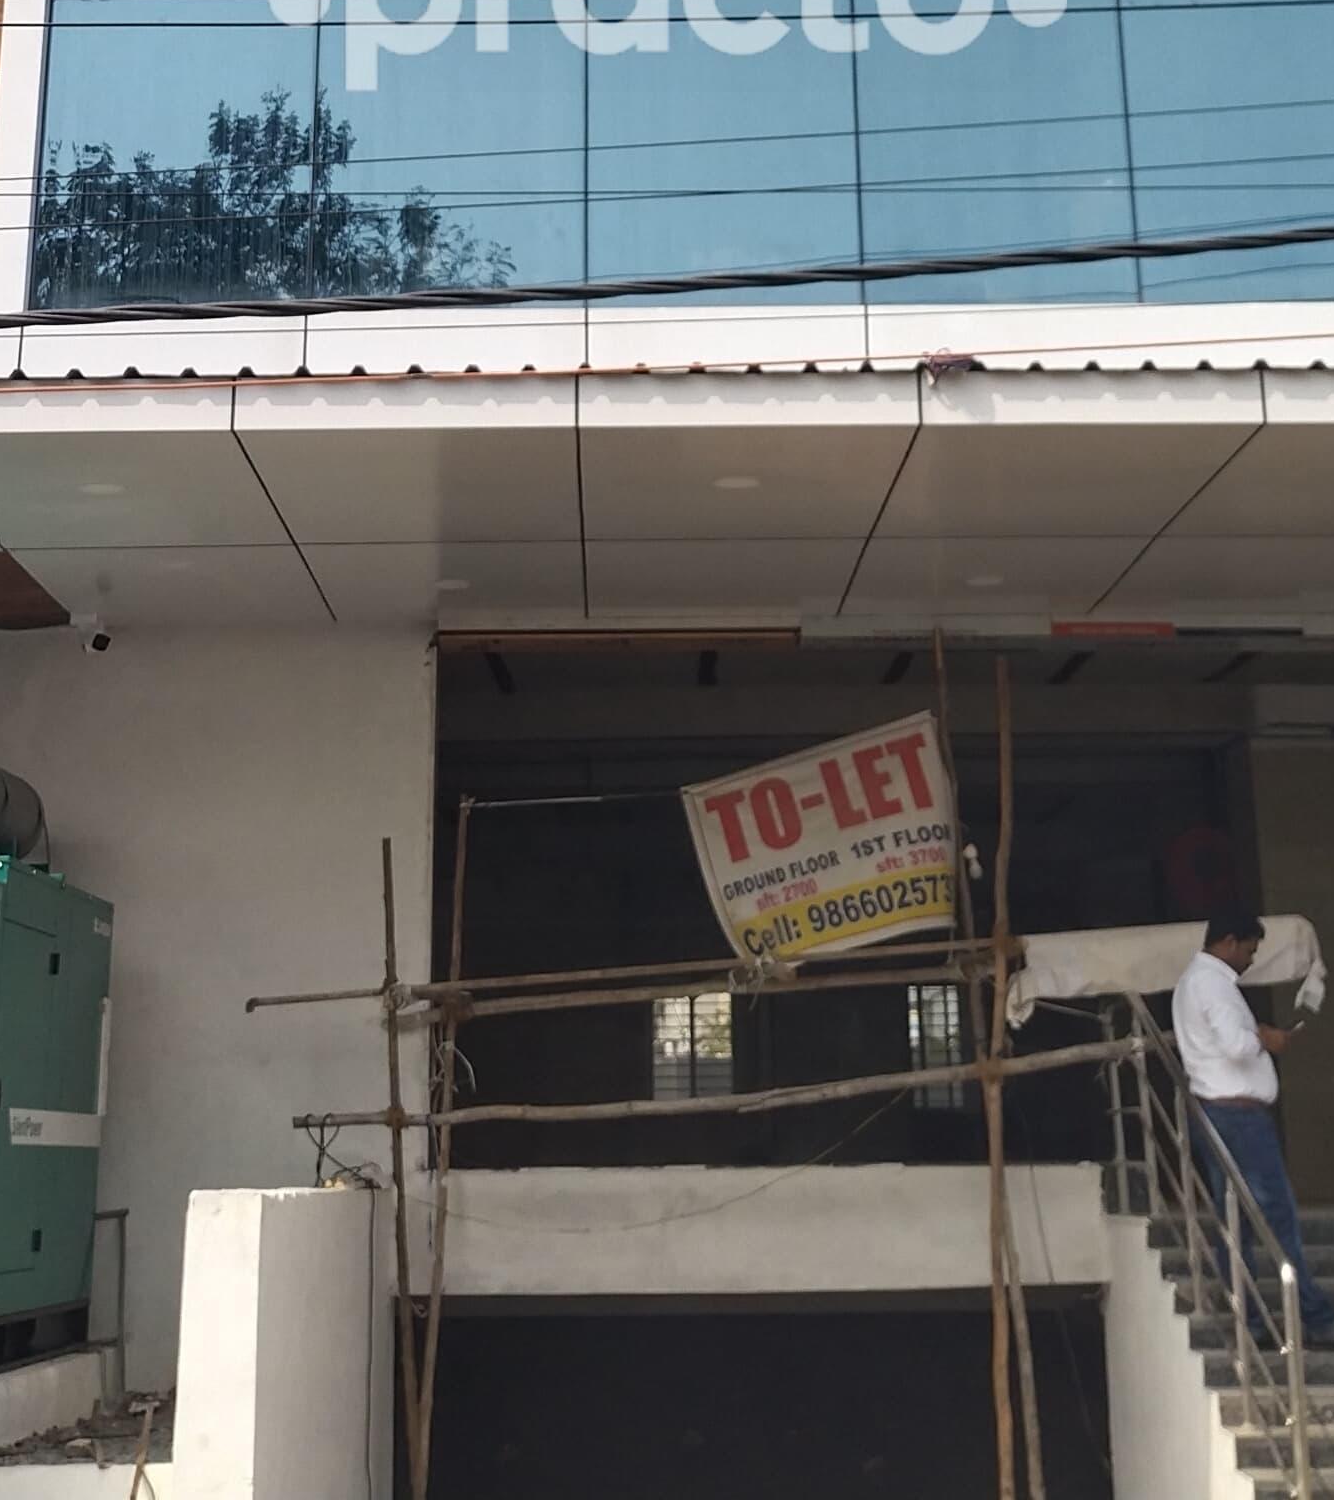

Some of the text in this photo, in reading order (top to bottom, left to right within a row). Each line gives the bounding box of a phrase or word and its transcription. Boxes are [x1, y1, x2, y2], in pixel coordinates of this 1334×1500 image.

[704, 732, 934, 863] TO-LET
[723, 866, 787, 901] GROUND
[789, 851, 841, 878] FLOOR
[851, 835, 886, 859] 1ST
[743, 913, 803, 957] Cell:
